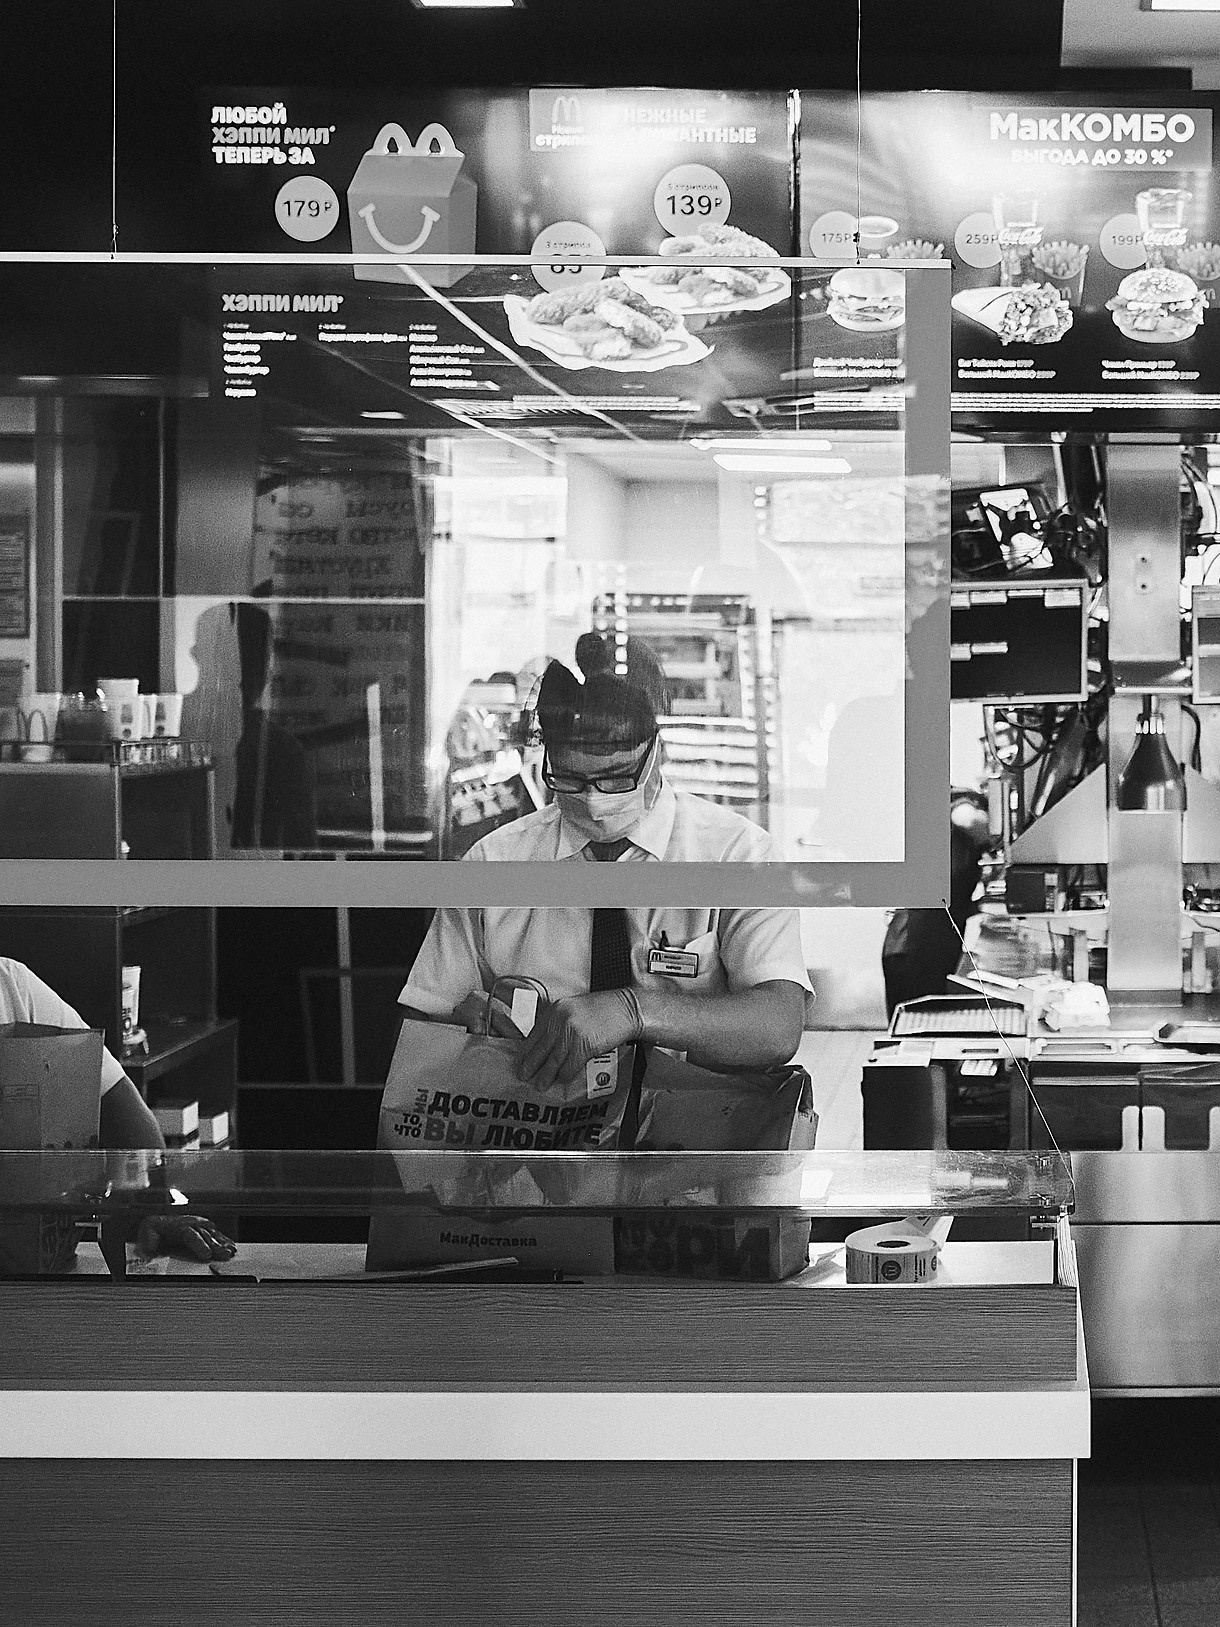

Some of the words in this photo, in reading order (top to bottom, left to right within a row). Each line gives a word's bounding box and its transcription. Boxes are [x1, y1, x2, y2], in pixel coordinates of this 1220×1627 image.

[211, 102, 287, 124] ЛЮБОЙ
[625, 107, 707, 124] НЕЖНЫЕ
[211, 127, 281, 145] ХЭППИ
[990, 112, 1195, 142] МакКОМБО
[211, 146, 286, 164] ТЕПЕРЬ
[288, 146, 316, 165] ЗА
[1011, 148, 1089, 166] ВЫГОДА
[1092, 149, 1121, 166] ДО
[1124, 149, 1148, 165] 30
[222, 294, 290, 312] ХЭППИ
[428, 1091, 610, 1126] ДОСТАВЛЯЕМ
[402, 1112, 423, 1128] ТО,
[393, 1123, 422, 1139] ЧТО
[423, 1117, 477, 1145] ВЫ
[481, 1123, 604, 1150] ЛЮБИТЕ
[439, 1232, 538, 1248] МакДоставка
